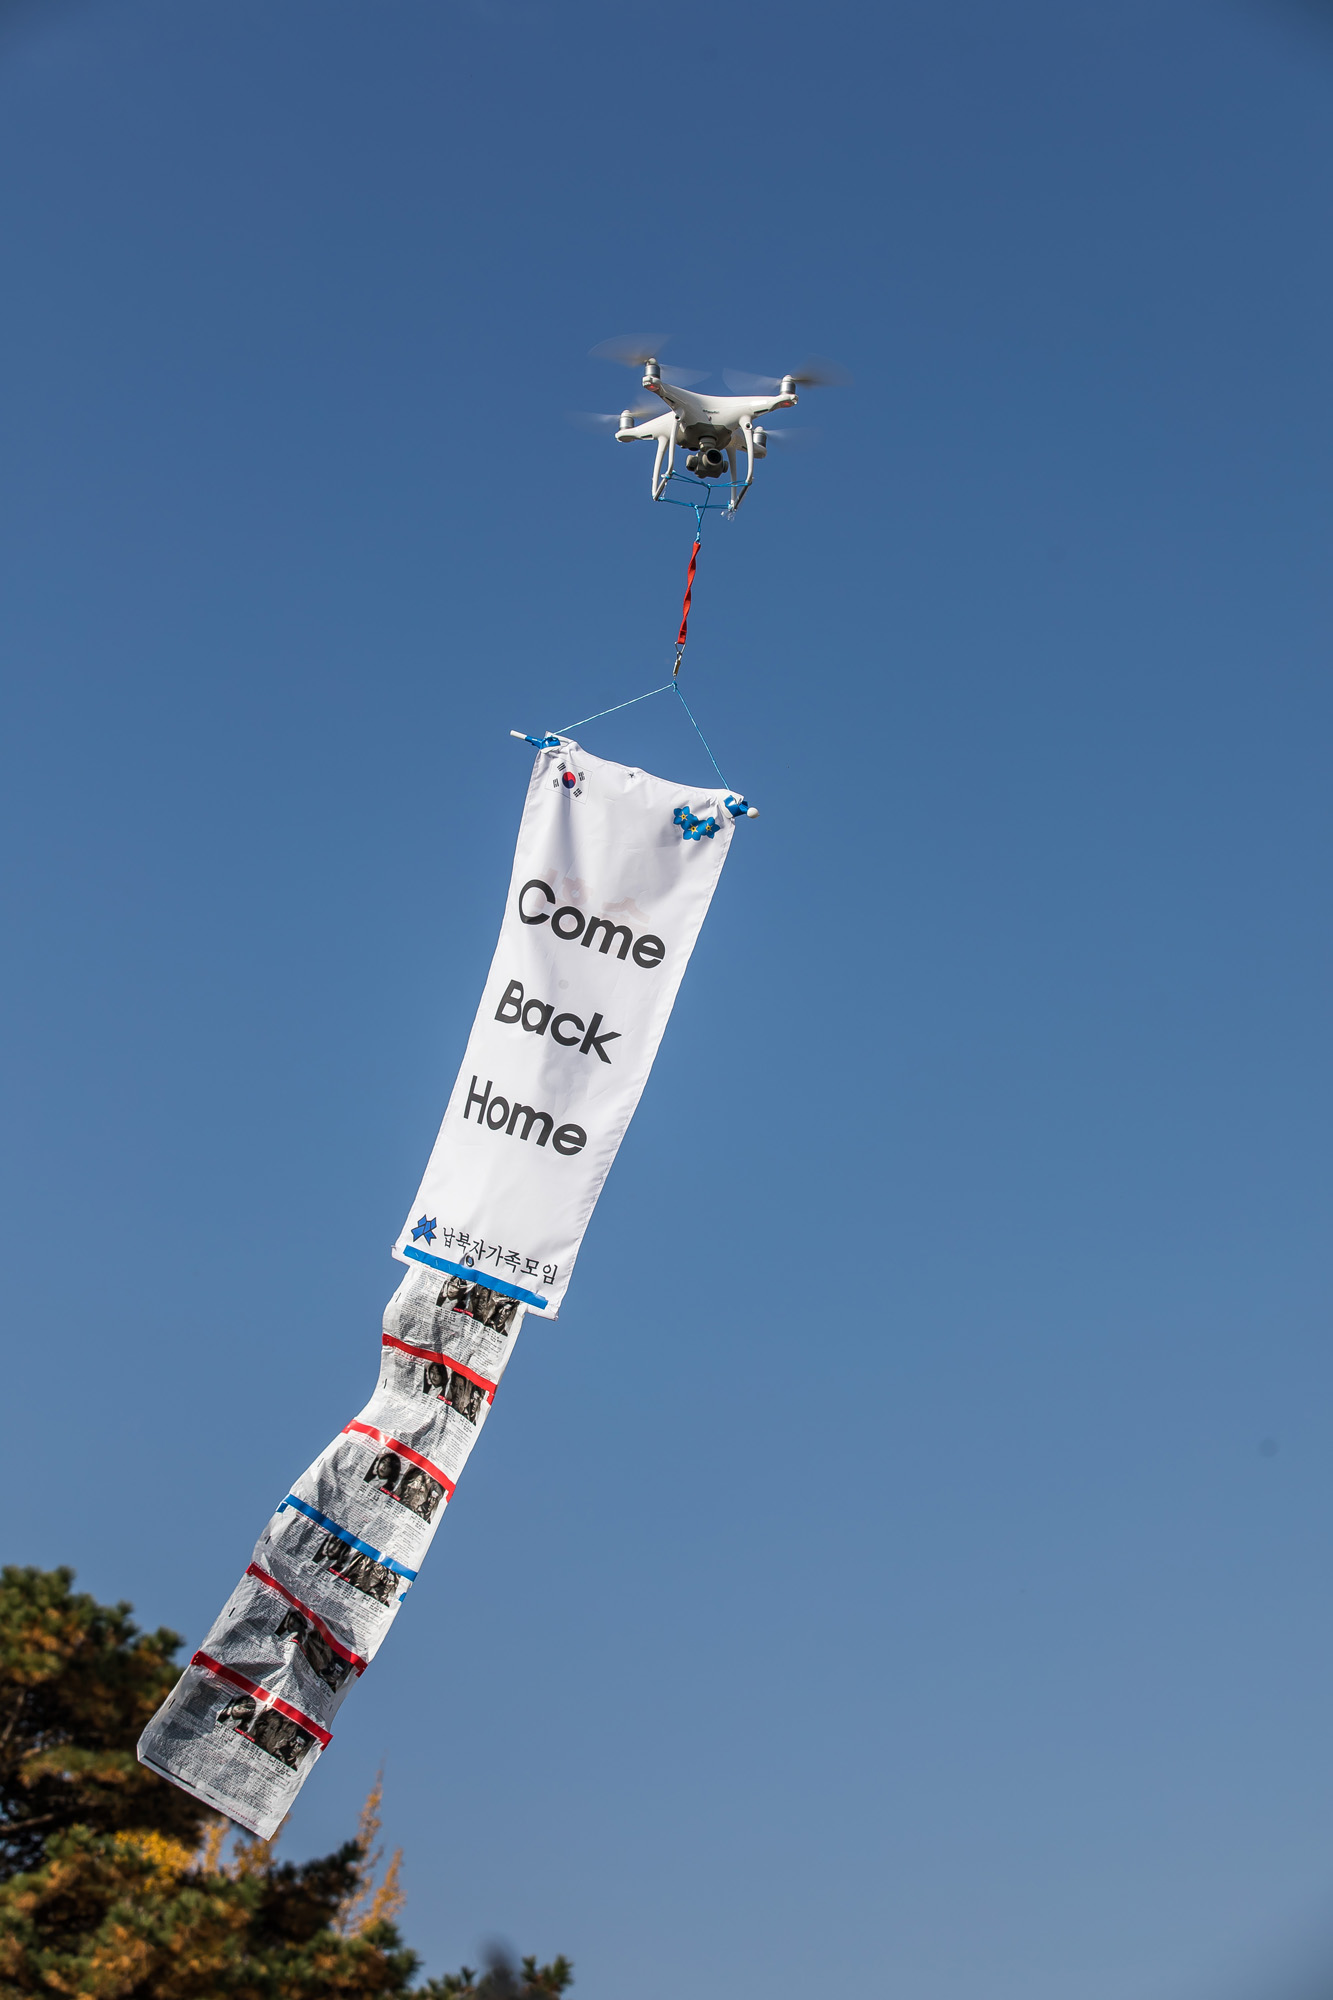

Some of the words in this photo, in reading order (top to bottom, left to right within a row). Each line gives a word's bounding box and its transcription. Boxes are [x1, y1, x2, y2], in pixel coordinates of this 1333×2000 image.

[519, 879, 666, 969] Come
[494, 979, 622, 1065] Back
[463, 1075, 588, 1156] Home
[443, 1227, 558, 1285] 납북자가족모임
